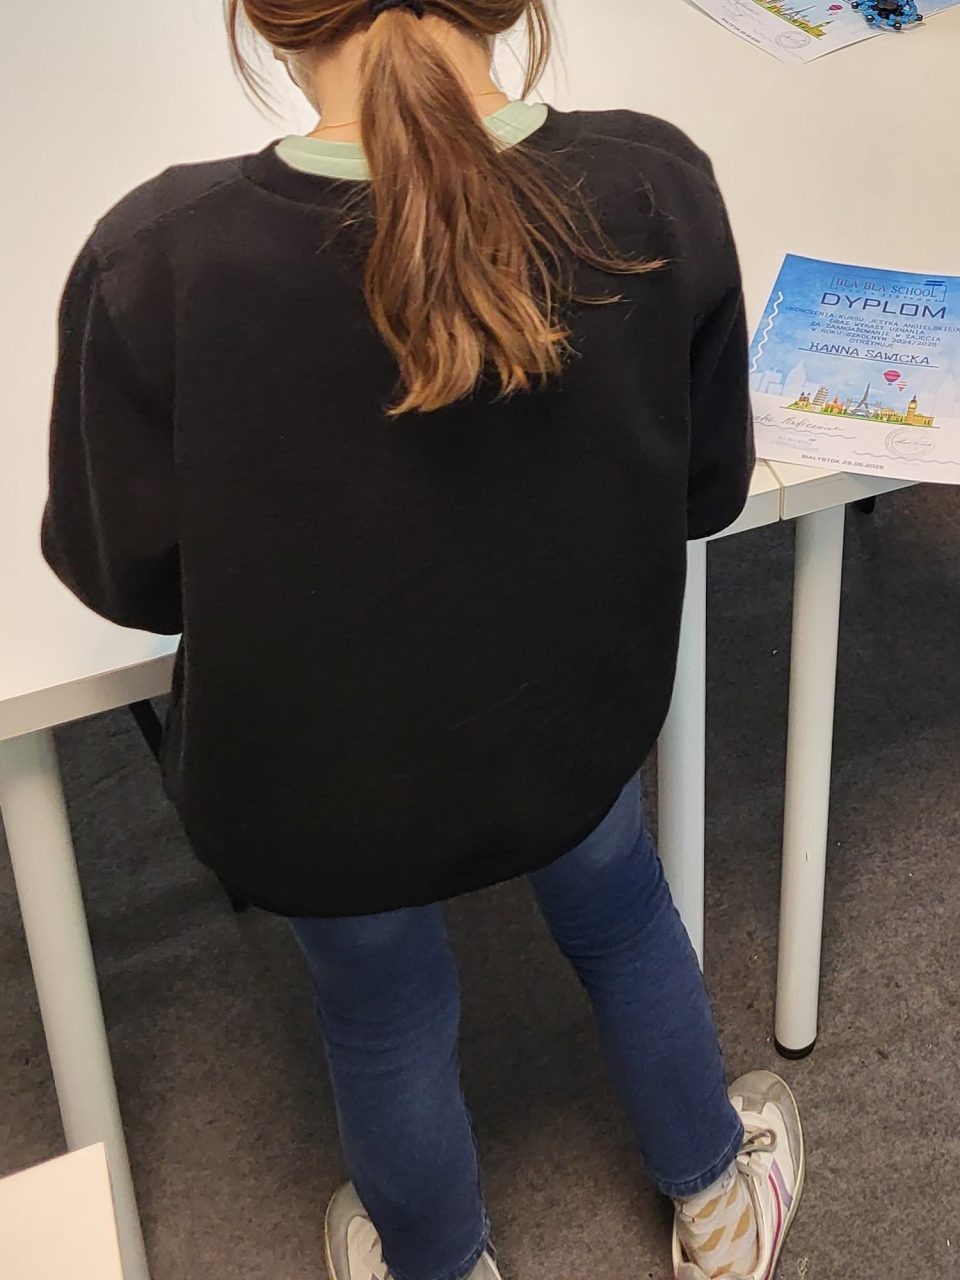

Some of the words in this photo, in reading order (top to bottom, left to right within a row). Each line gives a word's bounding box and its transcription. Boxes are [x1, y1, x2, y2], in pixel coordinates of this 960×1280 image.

[835, 277, 858, 289] BLA
[864, 281, 886, 293] BLA
[891, 285, 937, 298] SCHOOL
[821, 292, 947, 319] DYPLOM
[809, 342, 859, 356] HANNA
[865, 349, 930, 365] SAWICKA
